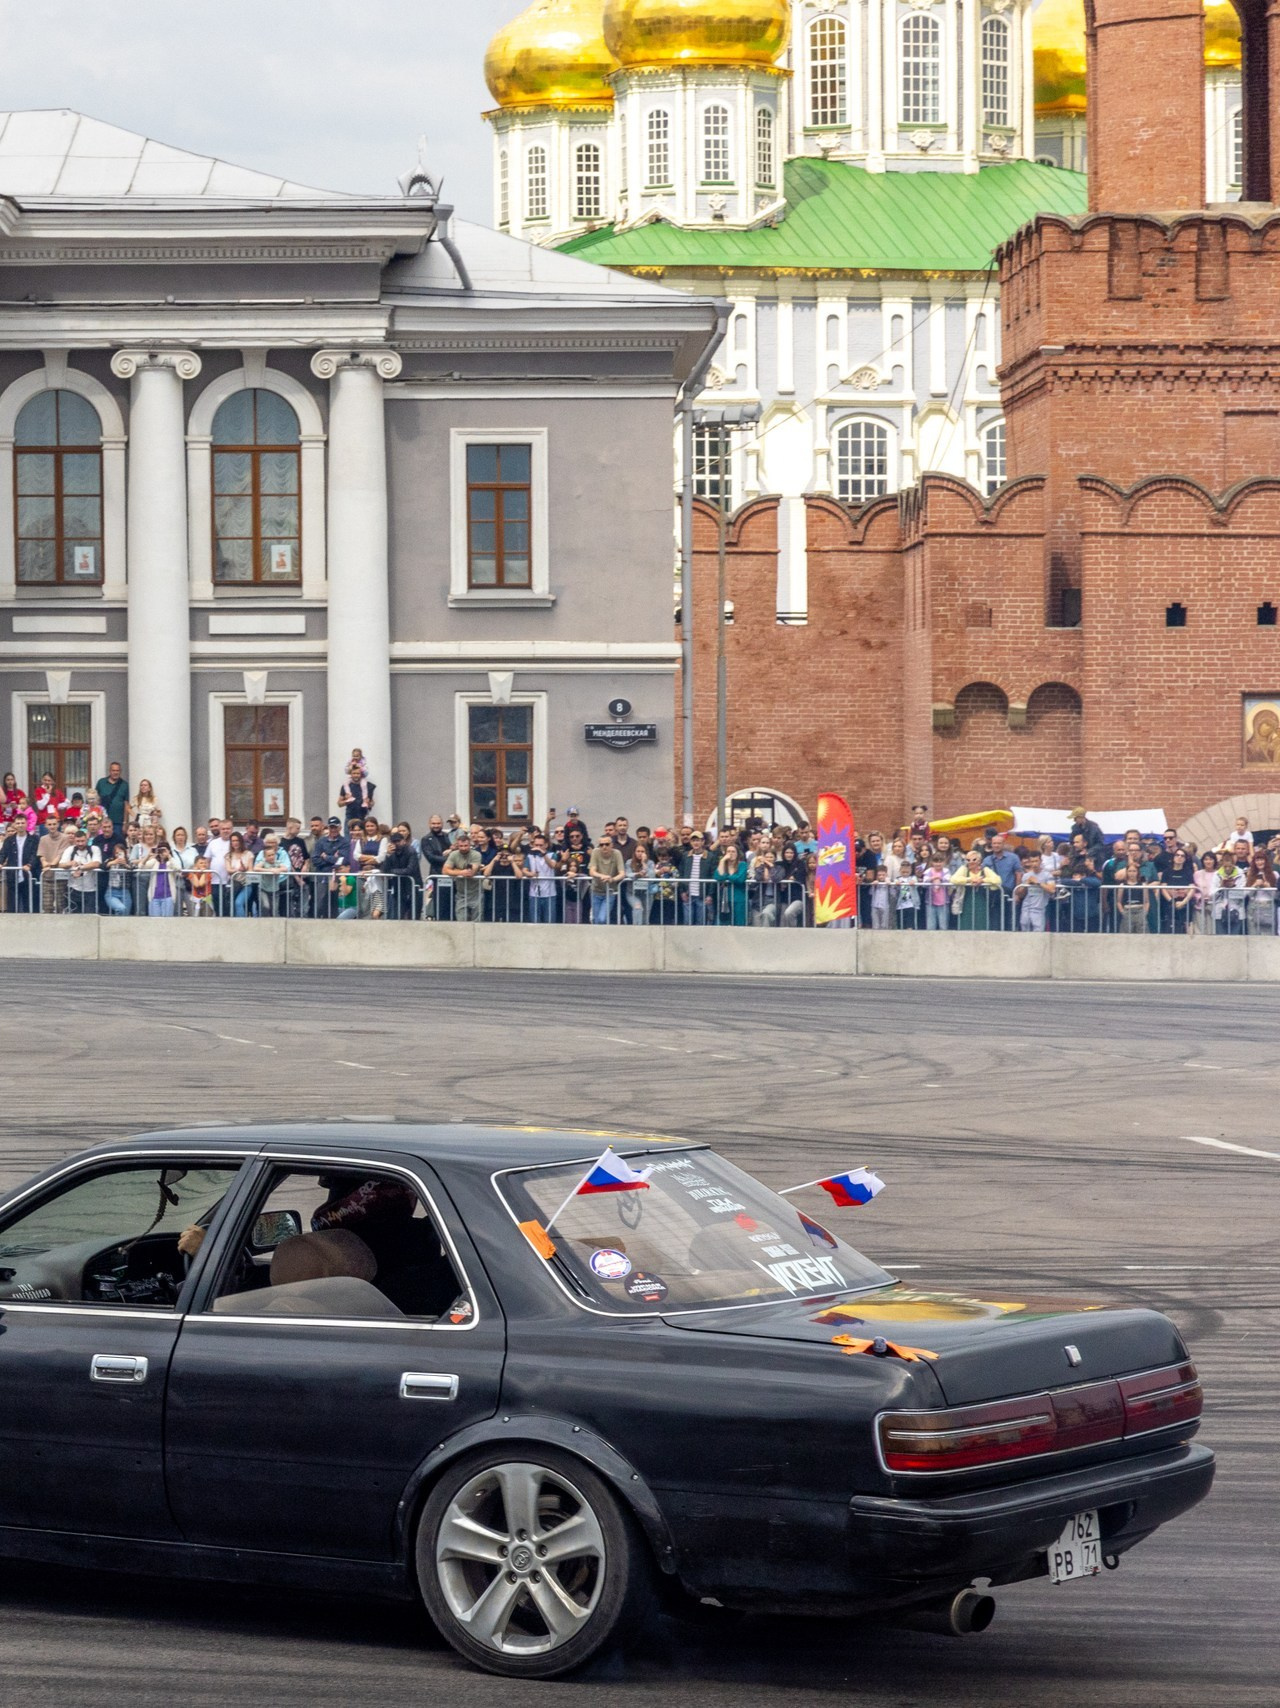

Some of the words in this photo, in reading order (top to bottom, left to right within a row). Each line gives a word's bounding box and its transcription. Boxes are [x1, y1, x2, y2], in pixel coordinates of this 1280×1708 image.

[616, 702, 623, 713] 8
[592, 730, 649, 738] МЕНДЕЛЕЕВСКАЯ
[1084, 1544, 1098, 1565] 71
